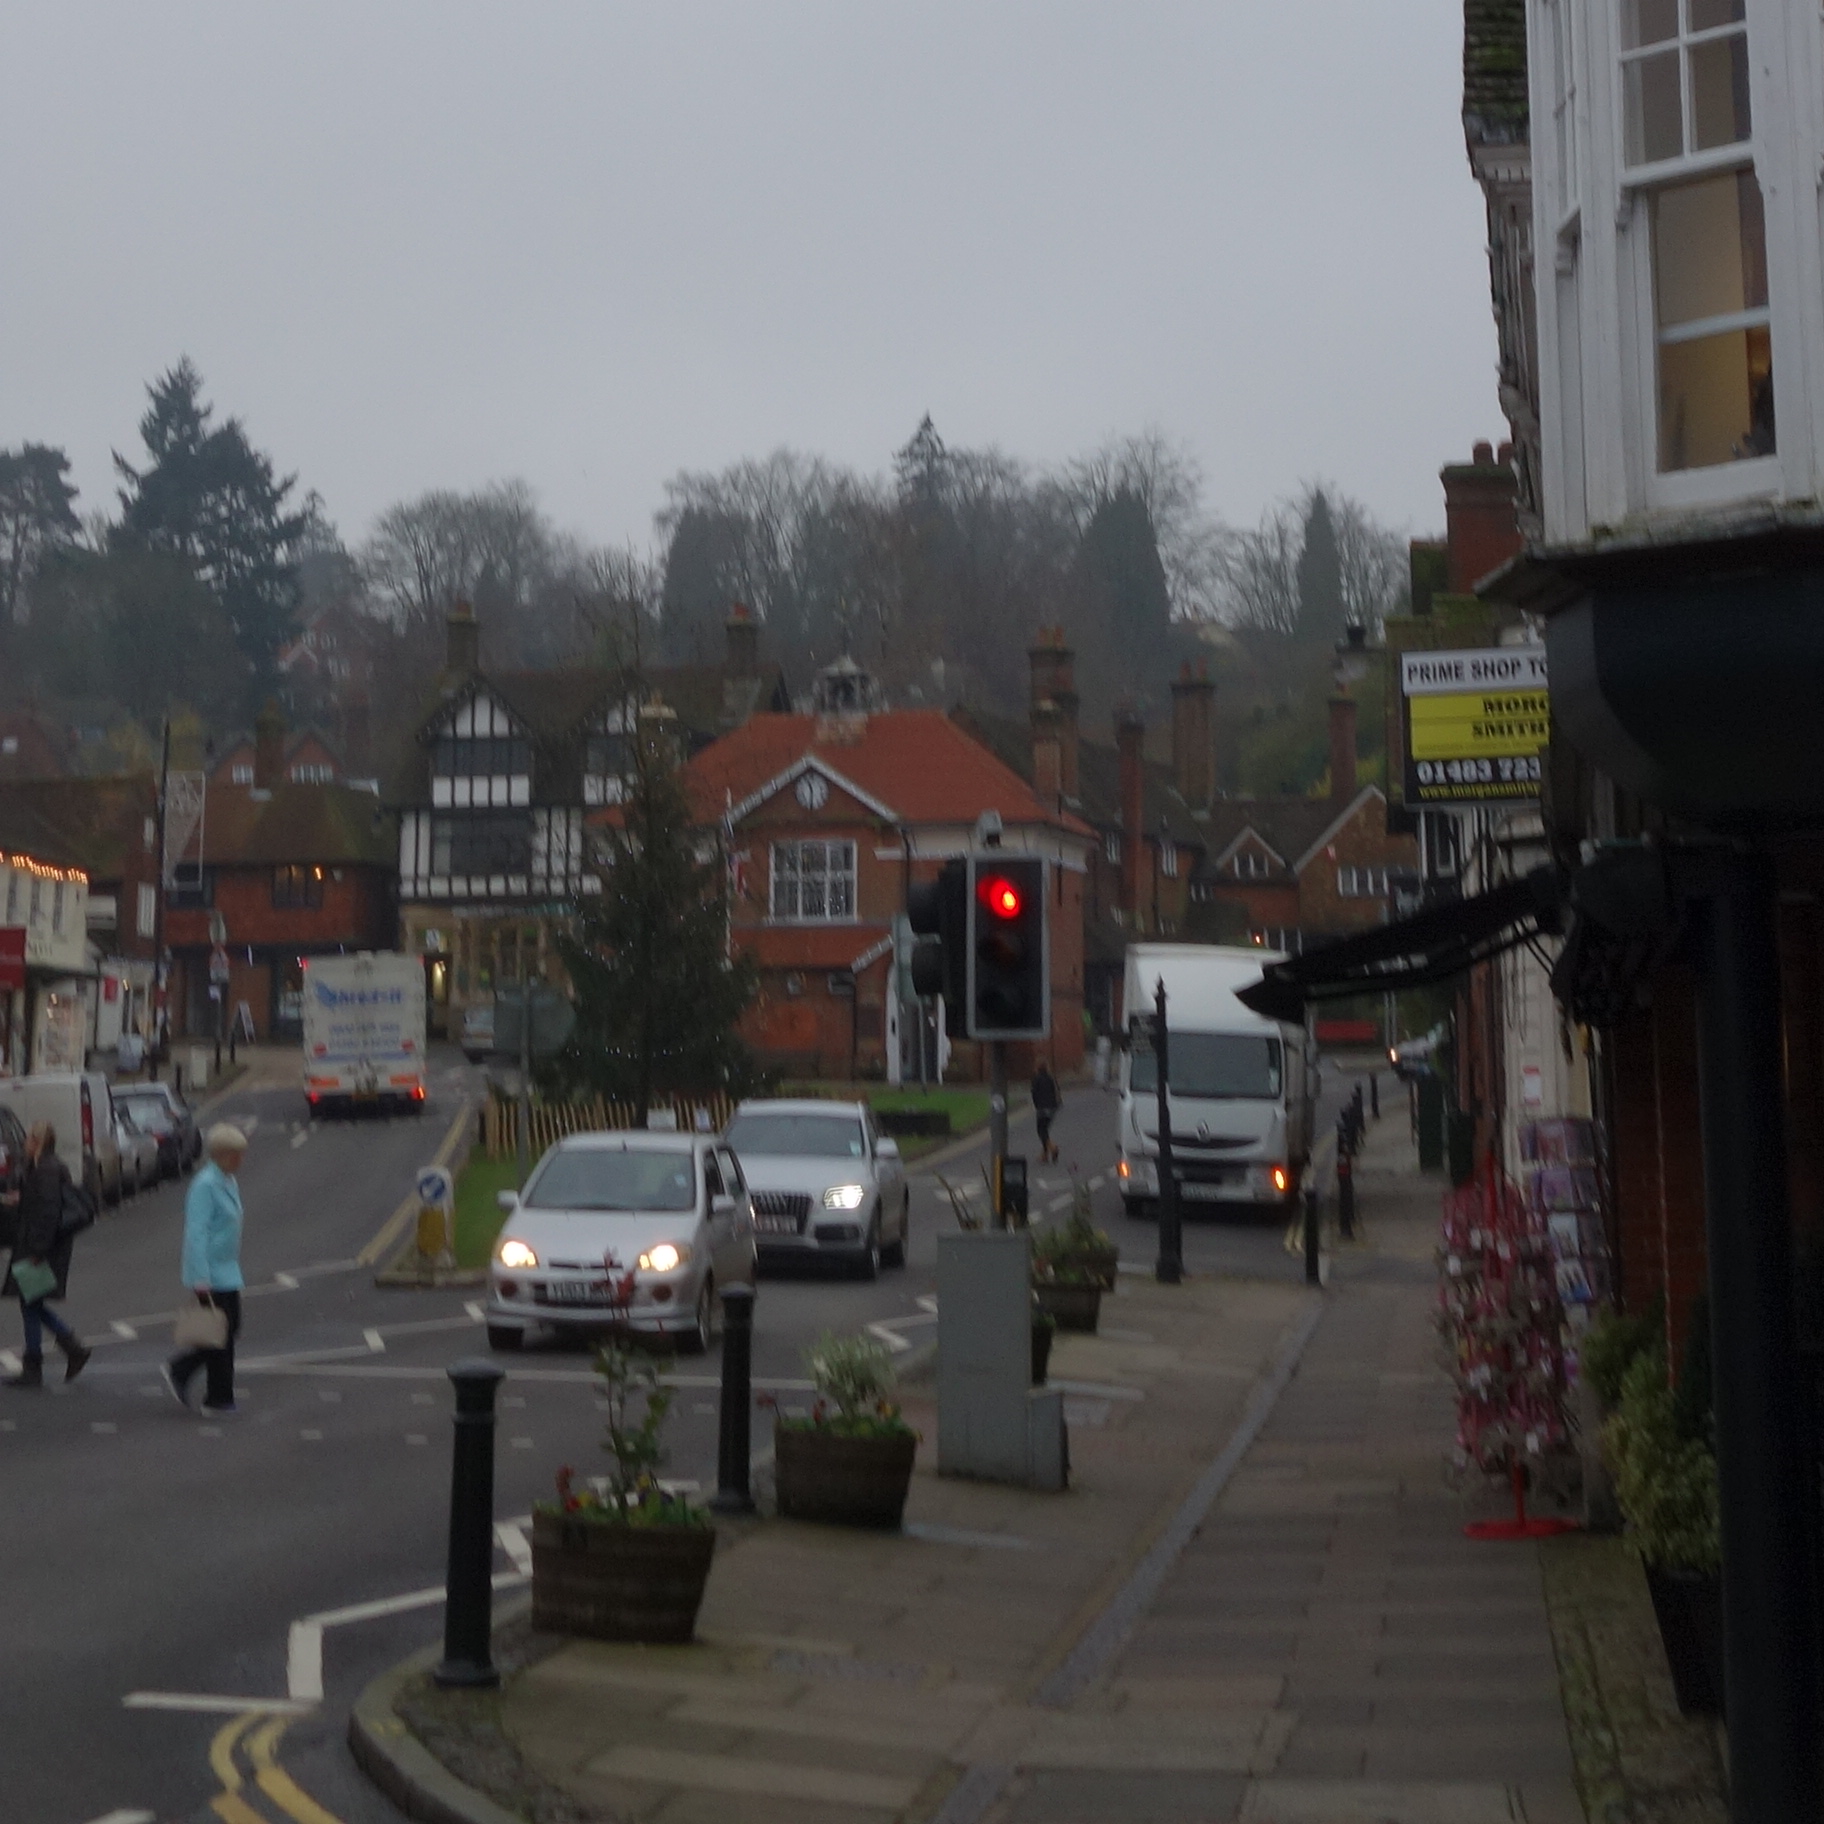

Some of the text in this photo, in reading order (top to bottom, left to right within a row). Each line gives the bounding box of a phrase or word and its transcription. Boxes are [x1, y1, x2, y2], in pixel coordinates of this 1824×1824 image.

[1407, 660, 1463, 683] PRIME
[1471, 657, 1521, 680] SHOP
[1416, 758, 1492, 785] 01483
